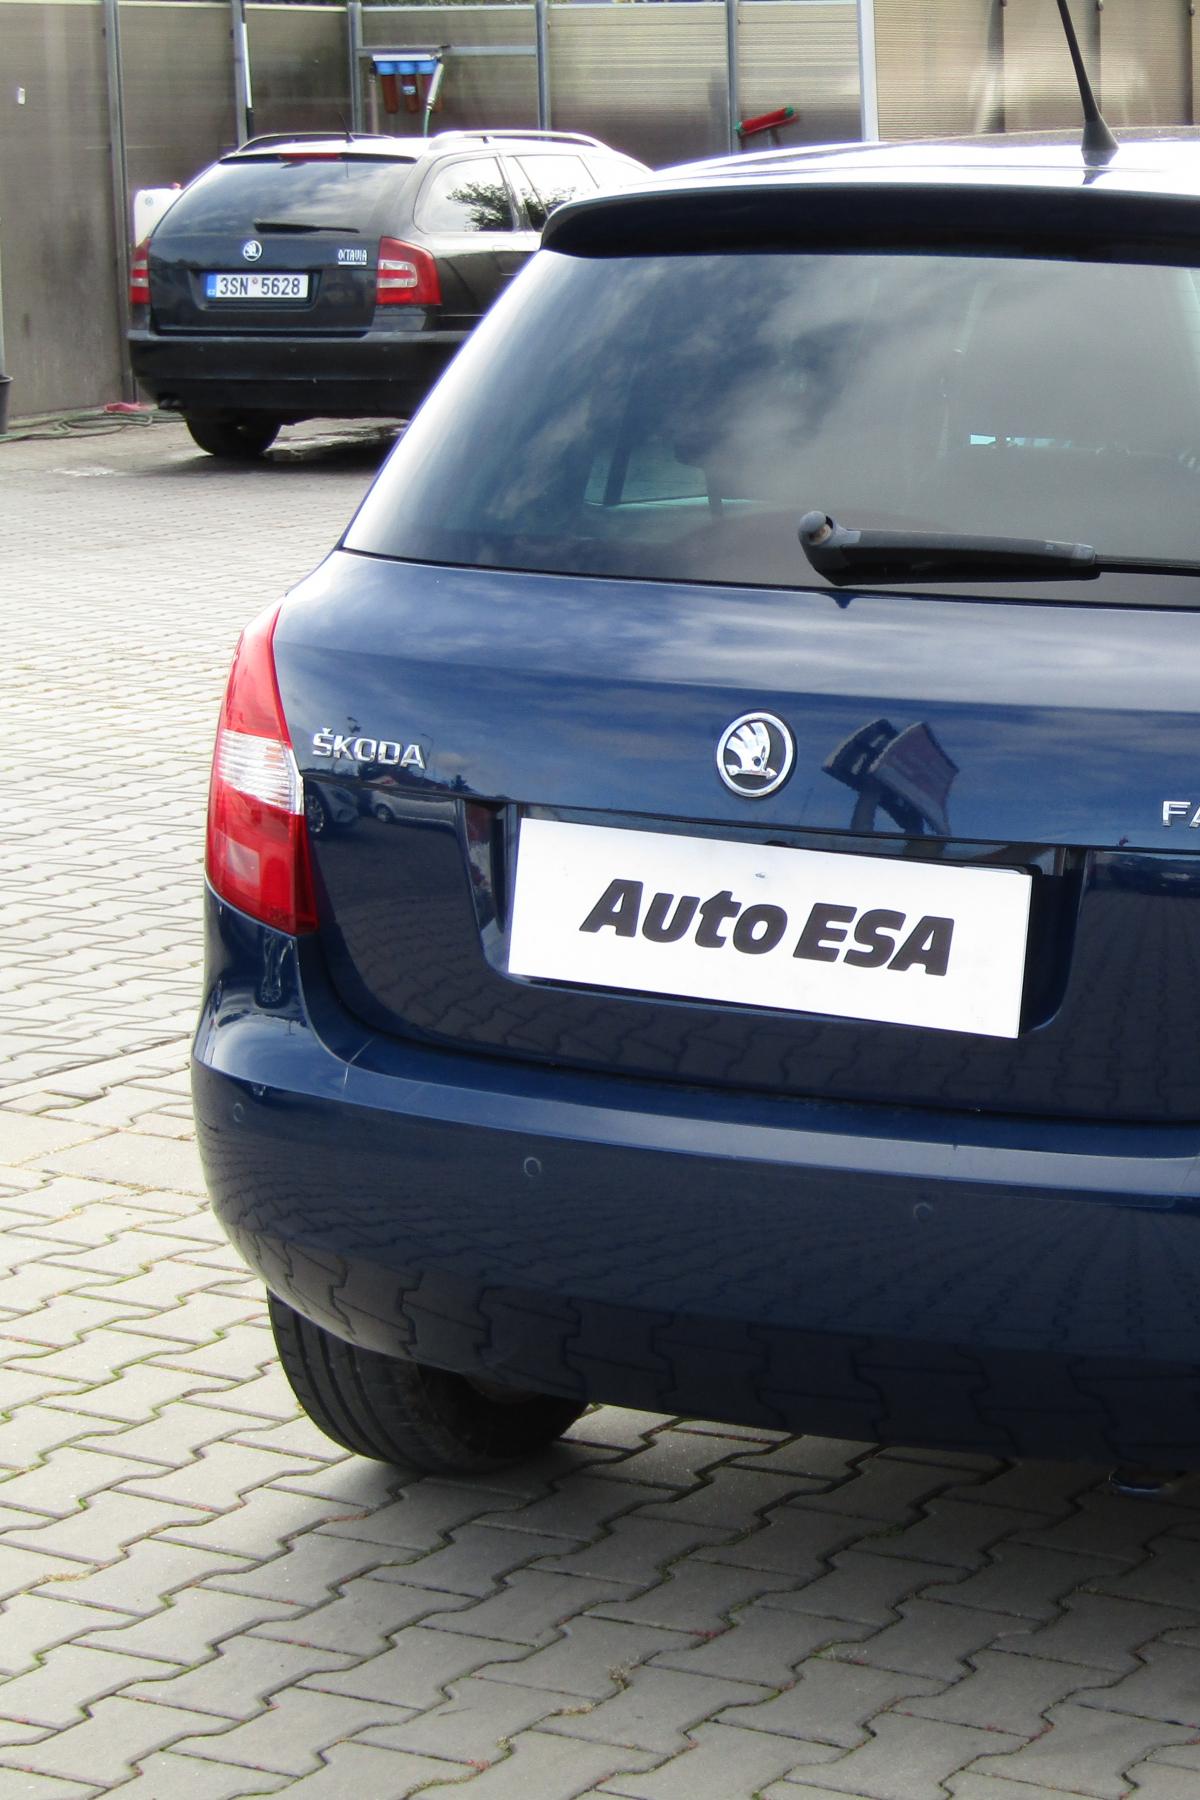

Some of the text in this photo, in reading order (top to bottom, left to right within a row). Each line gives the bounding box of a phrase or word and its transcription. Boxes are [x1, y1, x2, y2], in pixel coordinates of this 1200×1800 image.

[337, 248, 368, 262] OCTAVIA
[219, 277, 300, 295] 3SN 5628
[312, 727, 426, 770] ŠKODA
[578, 878, 955, 977] Auto ESA
